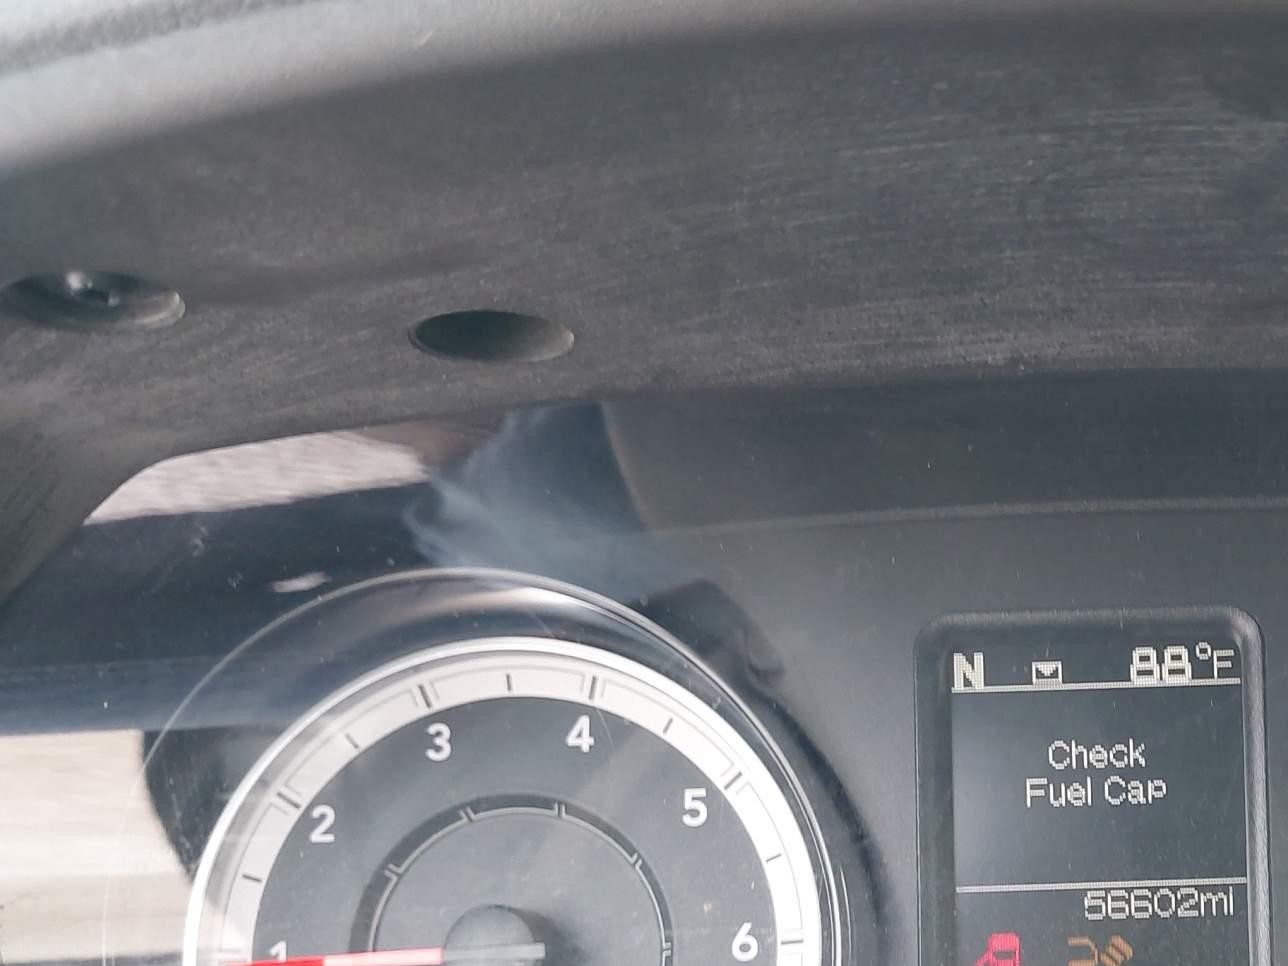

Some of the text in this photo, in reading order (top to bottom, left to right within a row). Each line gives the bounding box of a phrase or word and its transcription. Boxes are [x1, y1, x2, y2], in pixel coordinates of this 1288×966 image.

[953, 652, 984, 689] N
[424, 722, 453, 762] 3
[565, 715, 596, 753] 4
[1048, 738, 1146, 770] Check
[681, 787, 709, 828] 5
[1025, 775, 1167, 808] Fuel Cap
[309, 803, 337, 844] 2
[730, 922, 759, 962] 6
